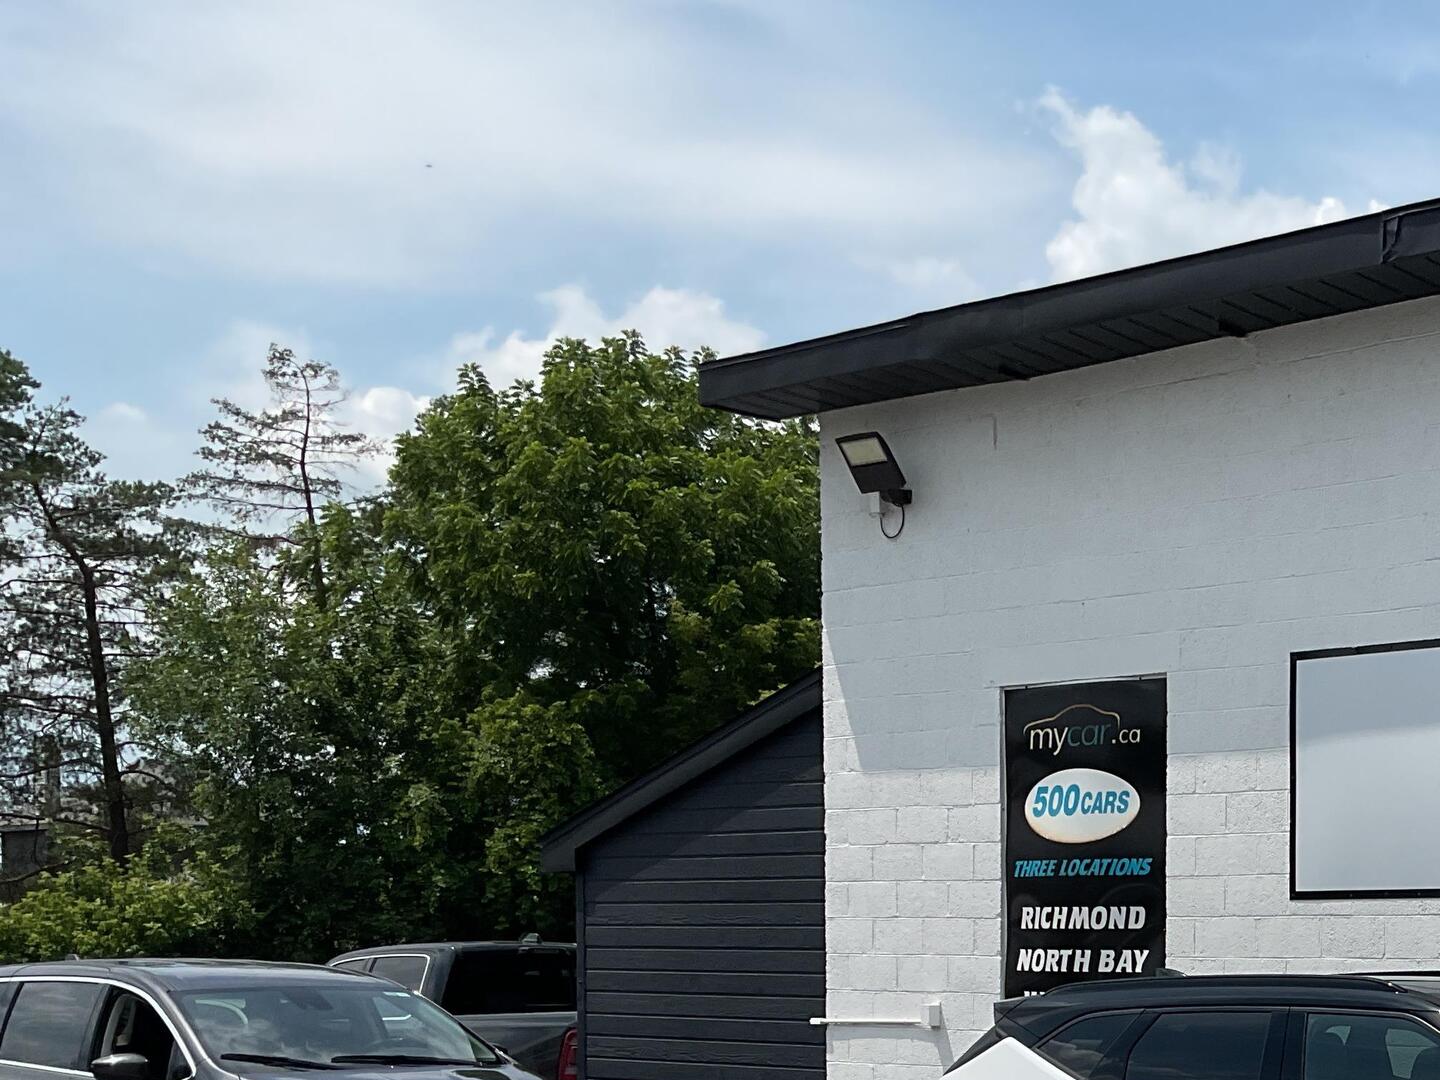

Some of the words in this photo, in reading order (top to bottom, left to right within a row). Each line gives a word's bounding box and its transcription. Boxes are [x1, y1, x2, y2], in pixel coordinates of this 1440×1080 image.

[1029, 722, 1141, 755] mycar.ca
[1014, 860, 1058, 878] THREE
[1058, 858, 1153, 877] LOCATIONS
[1020, 906, 1146, 930] RICHMOND
[1016, 949, 1092, 973] NORTH
[1099, 949, 1150, 973] BAY
